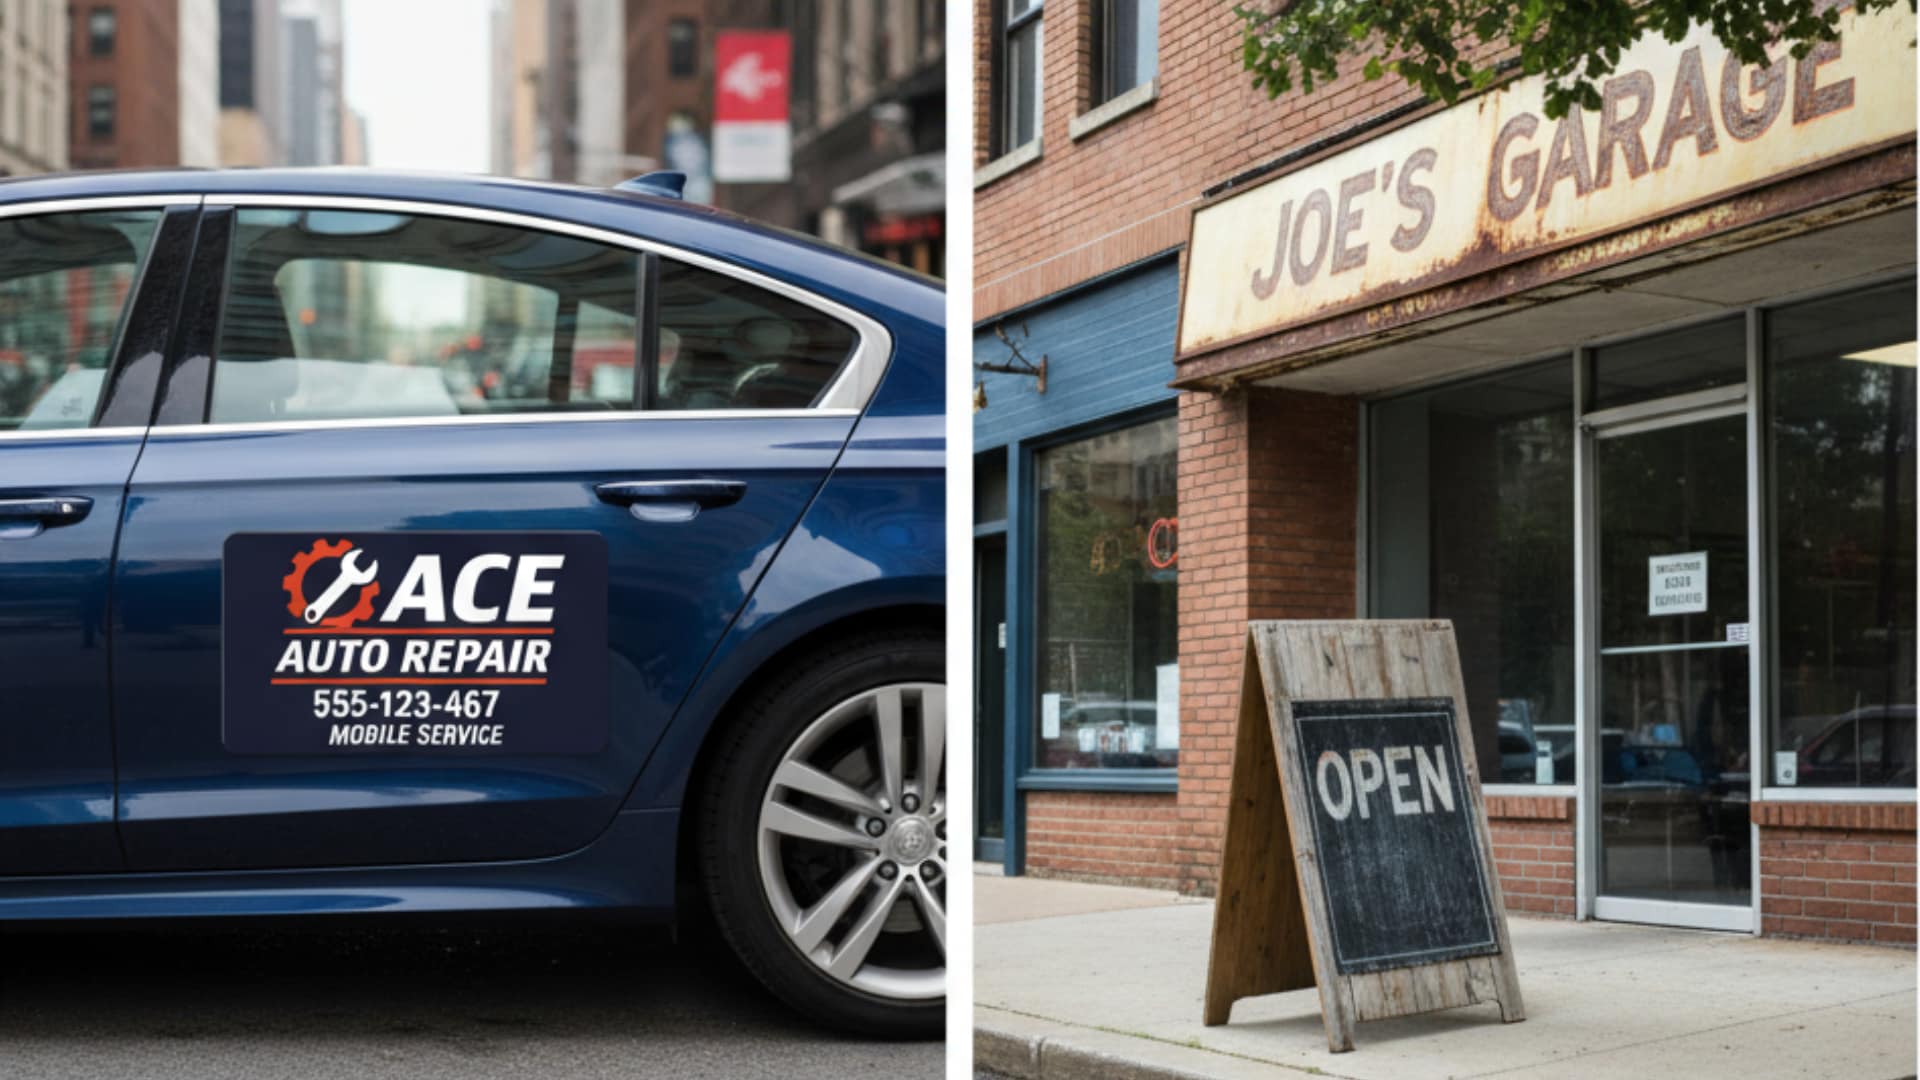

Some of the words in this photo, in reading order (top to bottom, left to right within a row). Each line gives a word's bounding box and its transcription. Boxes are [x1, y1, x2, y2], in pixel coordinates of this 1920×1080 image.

[1251, 147, 1438, 301] JOE'S
[1486, 0, 1856, 222] GARAGE
[379, 553, 565, 623] ACE
[275, 638, 390, 673] AUTO
[400, 639, 552, 673] REPAIR
[313, 688, 500, 719] 555-123-467
[328, 723, 412, 746] MOBILE
[416, 723, 505, 746] SERVICE
[1316, 744, 1456, 821] OPEN
